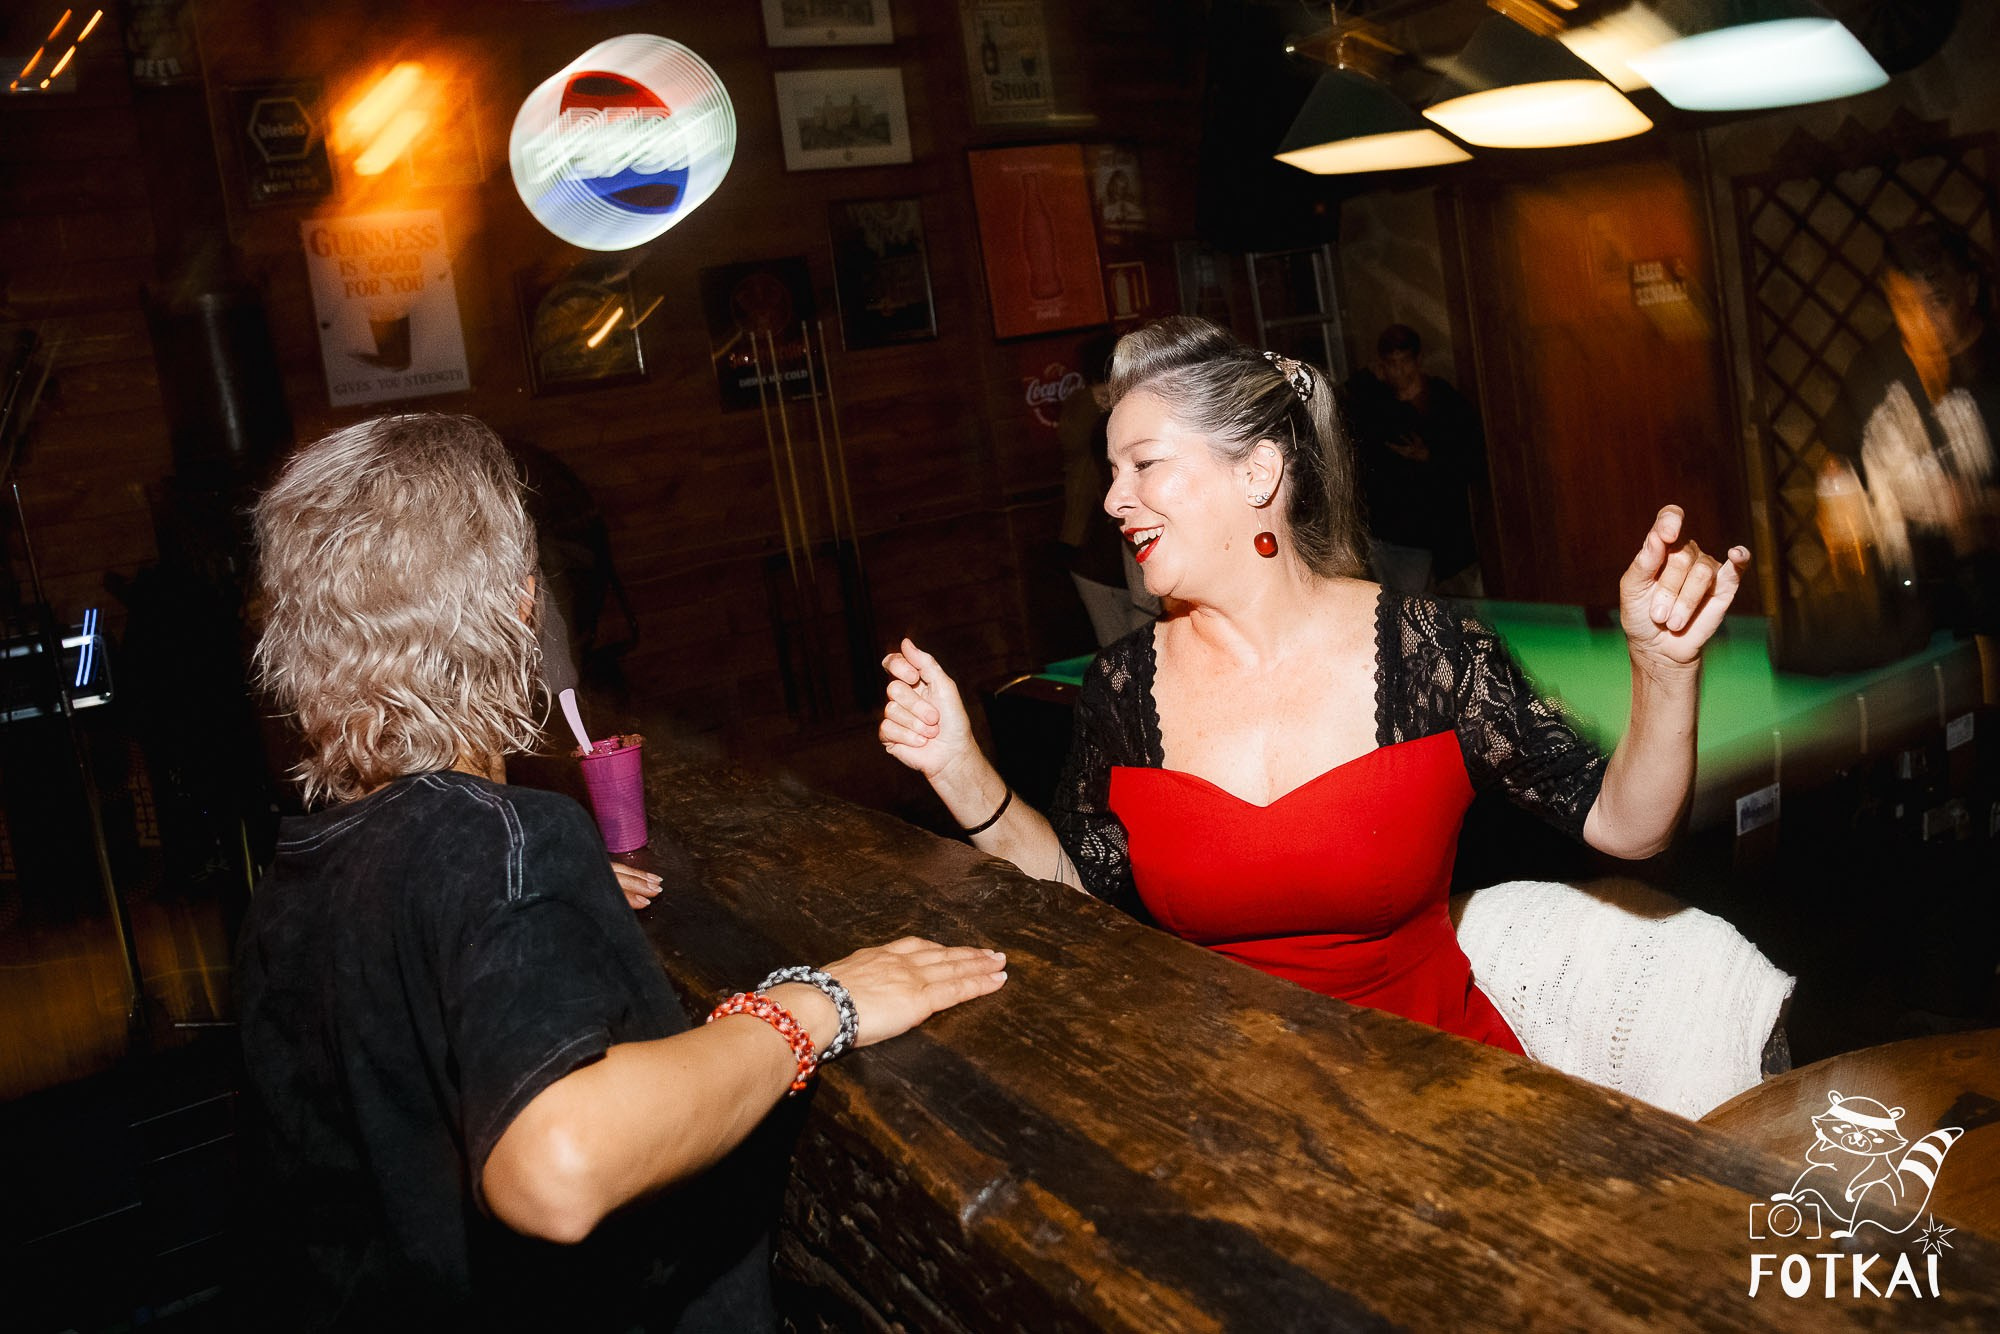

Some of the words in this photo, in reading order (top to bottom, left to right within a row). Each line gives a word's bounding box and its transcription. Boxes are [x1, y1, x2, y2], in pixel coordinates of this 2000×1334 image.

[309, 224, 439, 258] GUINNESS
[339, 259, 358, 276] IS
[368, 255, 421, 274] GOOD
[345, 278, 381, 298] FOR
[385, 275, 425, 293] YOU
[333, 379, 371, 396] GIVES
[377, 376, 399, 390] YOU
[405, 370, 464, 386] STRENGTH
[784, 369, 809, 381] COLD
